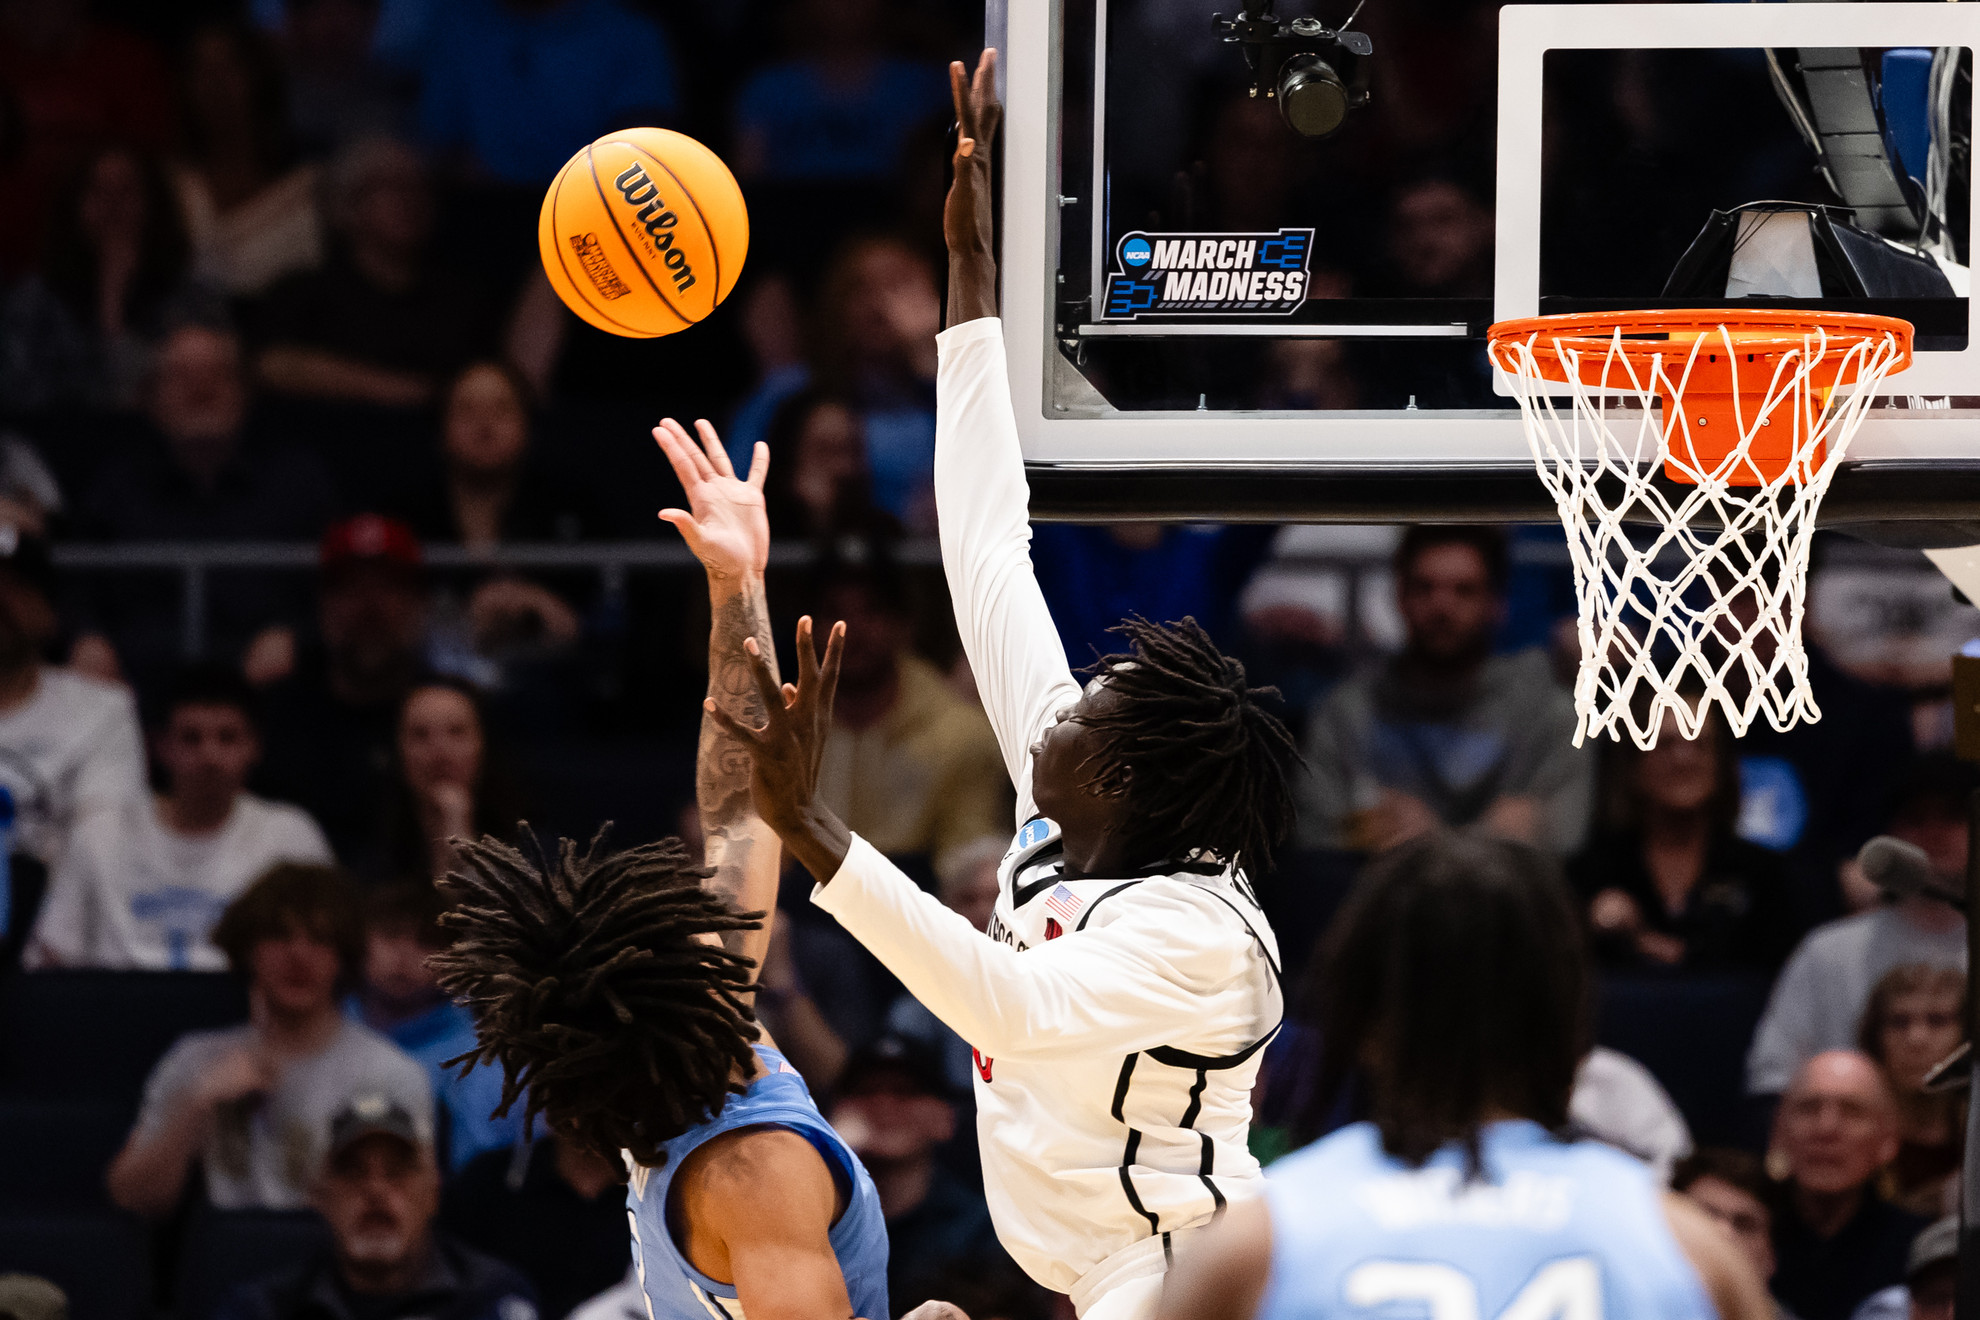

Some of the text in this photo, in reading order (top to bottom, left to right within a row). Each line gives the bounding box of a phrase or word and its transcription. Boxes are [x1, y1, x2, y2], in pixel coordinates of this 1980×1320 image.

[614, 160, 697, 295] Wilson
[1126, 251, 1151, 260] NCAA
[1152, 240, 1257, 269] MARCH
[1163, 272, 1304, 301] MADNESS
